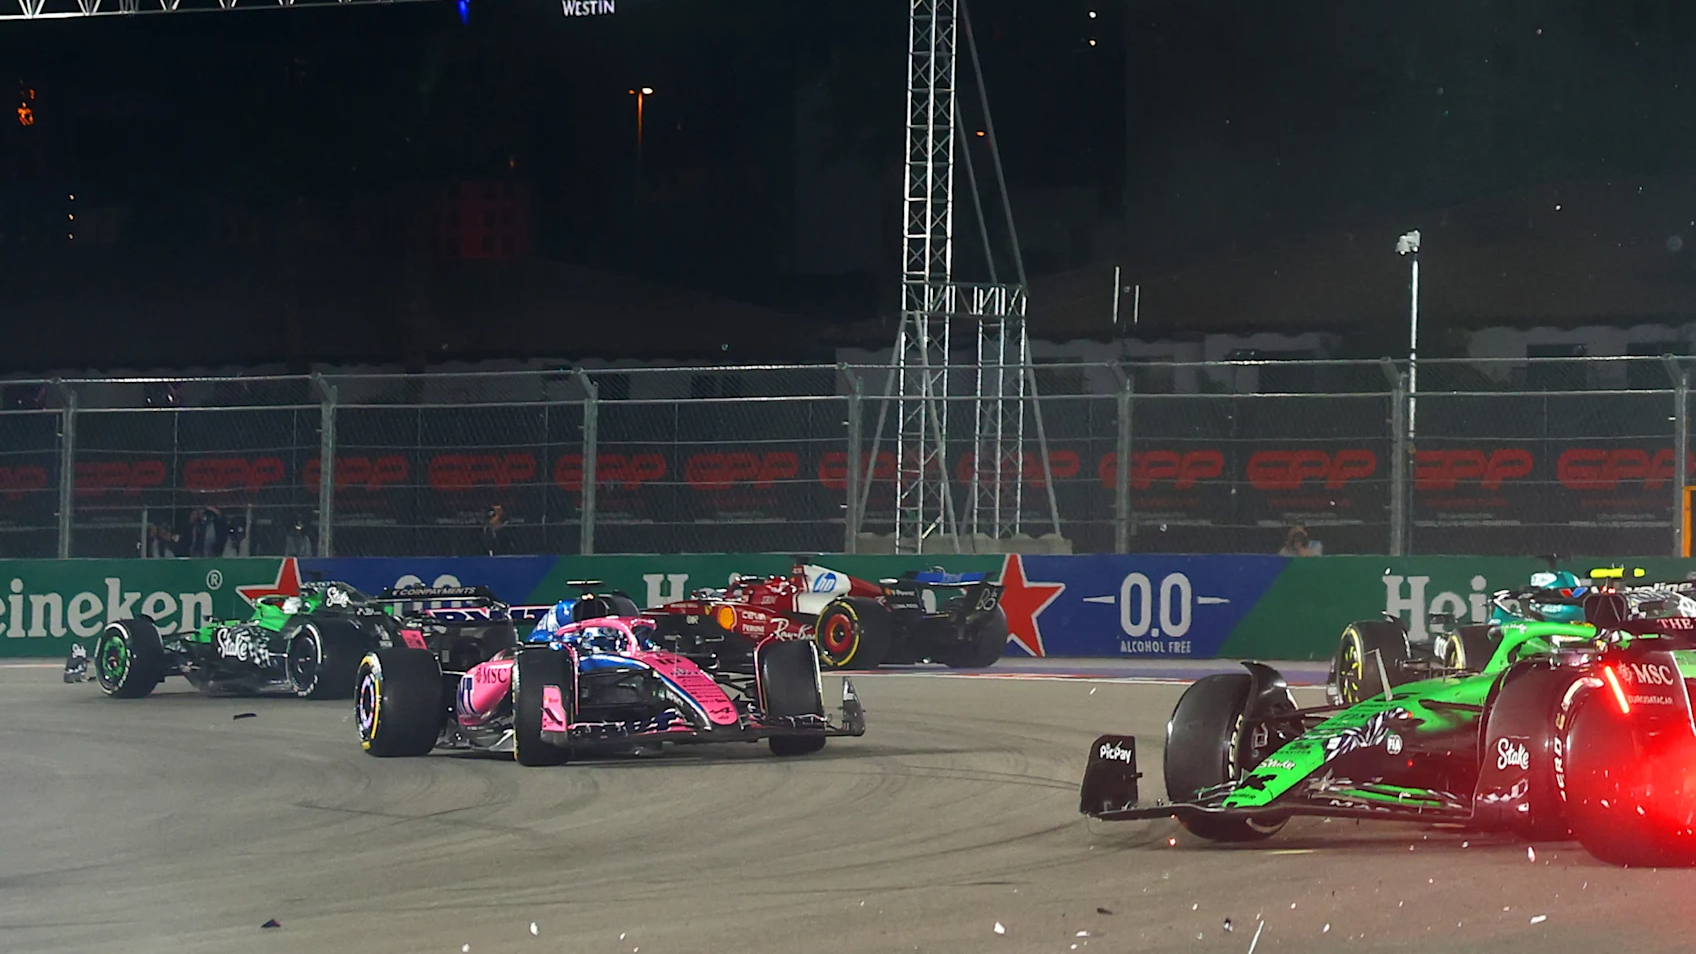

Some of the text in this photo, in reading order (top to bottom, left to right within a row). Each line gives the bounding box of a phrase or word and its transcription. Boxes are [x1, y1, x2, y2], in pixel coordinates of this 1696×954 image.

[562, 0, 615, 17] WESTIN
[400, 587, 477, 596] COINPAYMENTS
[1120, 572, 1192, 638] 0.0
[1657, 616, 1694, 630] THE
[1120, 640, 1192, 654] ALCOHOL FREE
[483, 667, 508, 684] MSC
[1637, 663, 1674, 686] MSC
[1099, 744, 1131, 764] PicPay
[1497, 738, 1530, 770] Stake
